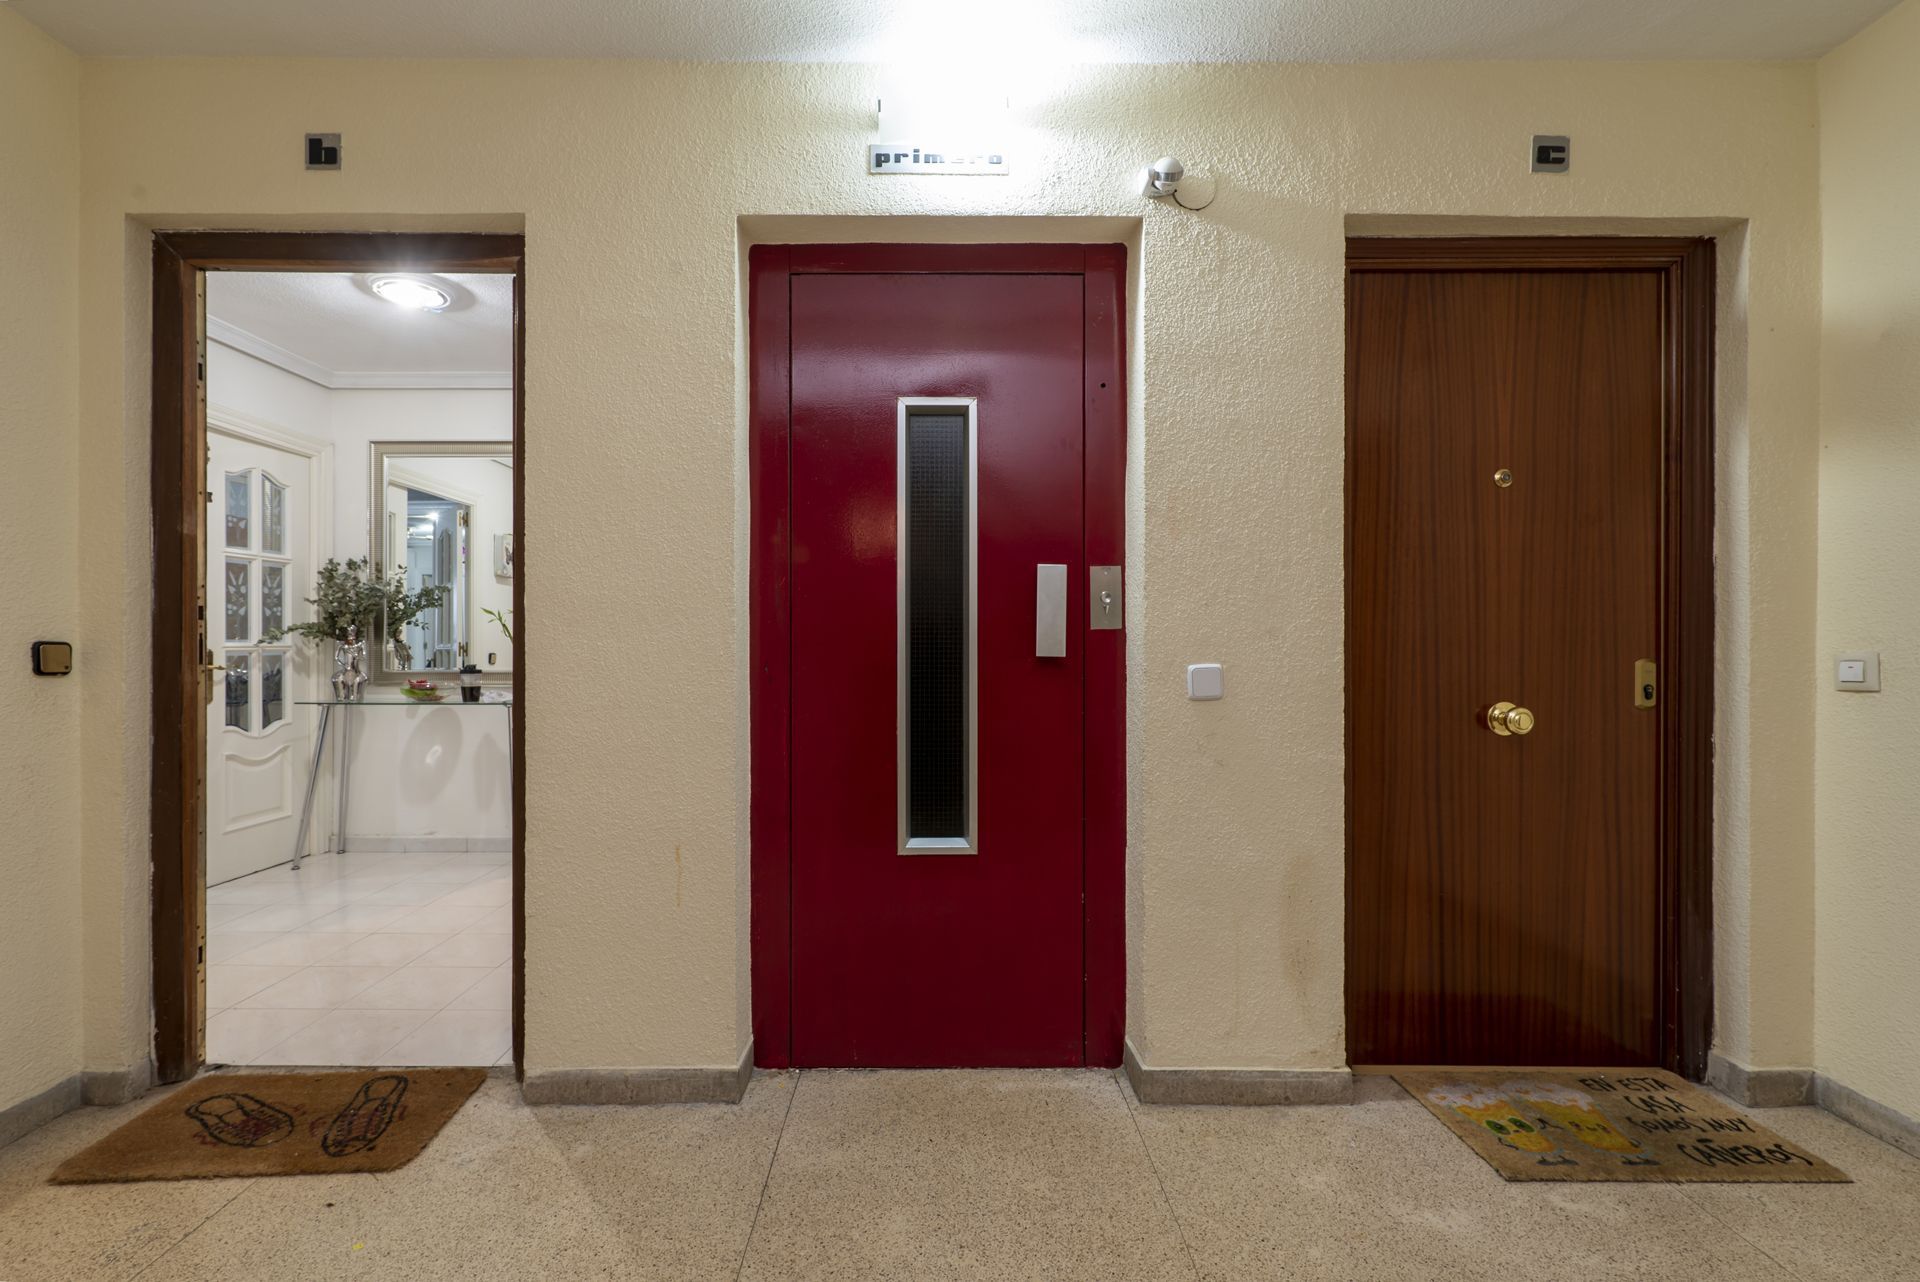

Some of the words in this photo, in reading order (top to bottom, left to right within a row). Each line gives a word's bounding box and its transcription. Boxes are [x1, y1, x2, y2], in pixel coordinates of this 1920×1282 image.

[309, 138, 338, 165] b
[875, 148, 1003, 168] primo
[1536, 145, 1566, 164] c
[1578, 1077, 1617, 1092] EN
[1616, 1076, 1678, 1092] ESTA
[1622, 1095, 1696, 1115] CASA
[1625, 1115, 1707, 1134] SOMOS
[1701, 1117, 1756, 1134] MUY
[1677, 1138, 1814, 1167] CAÑEROS
